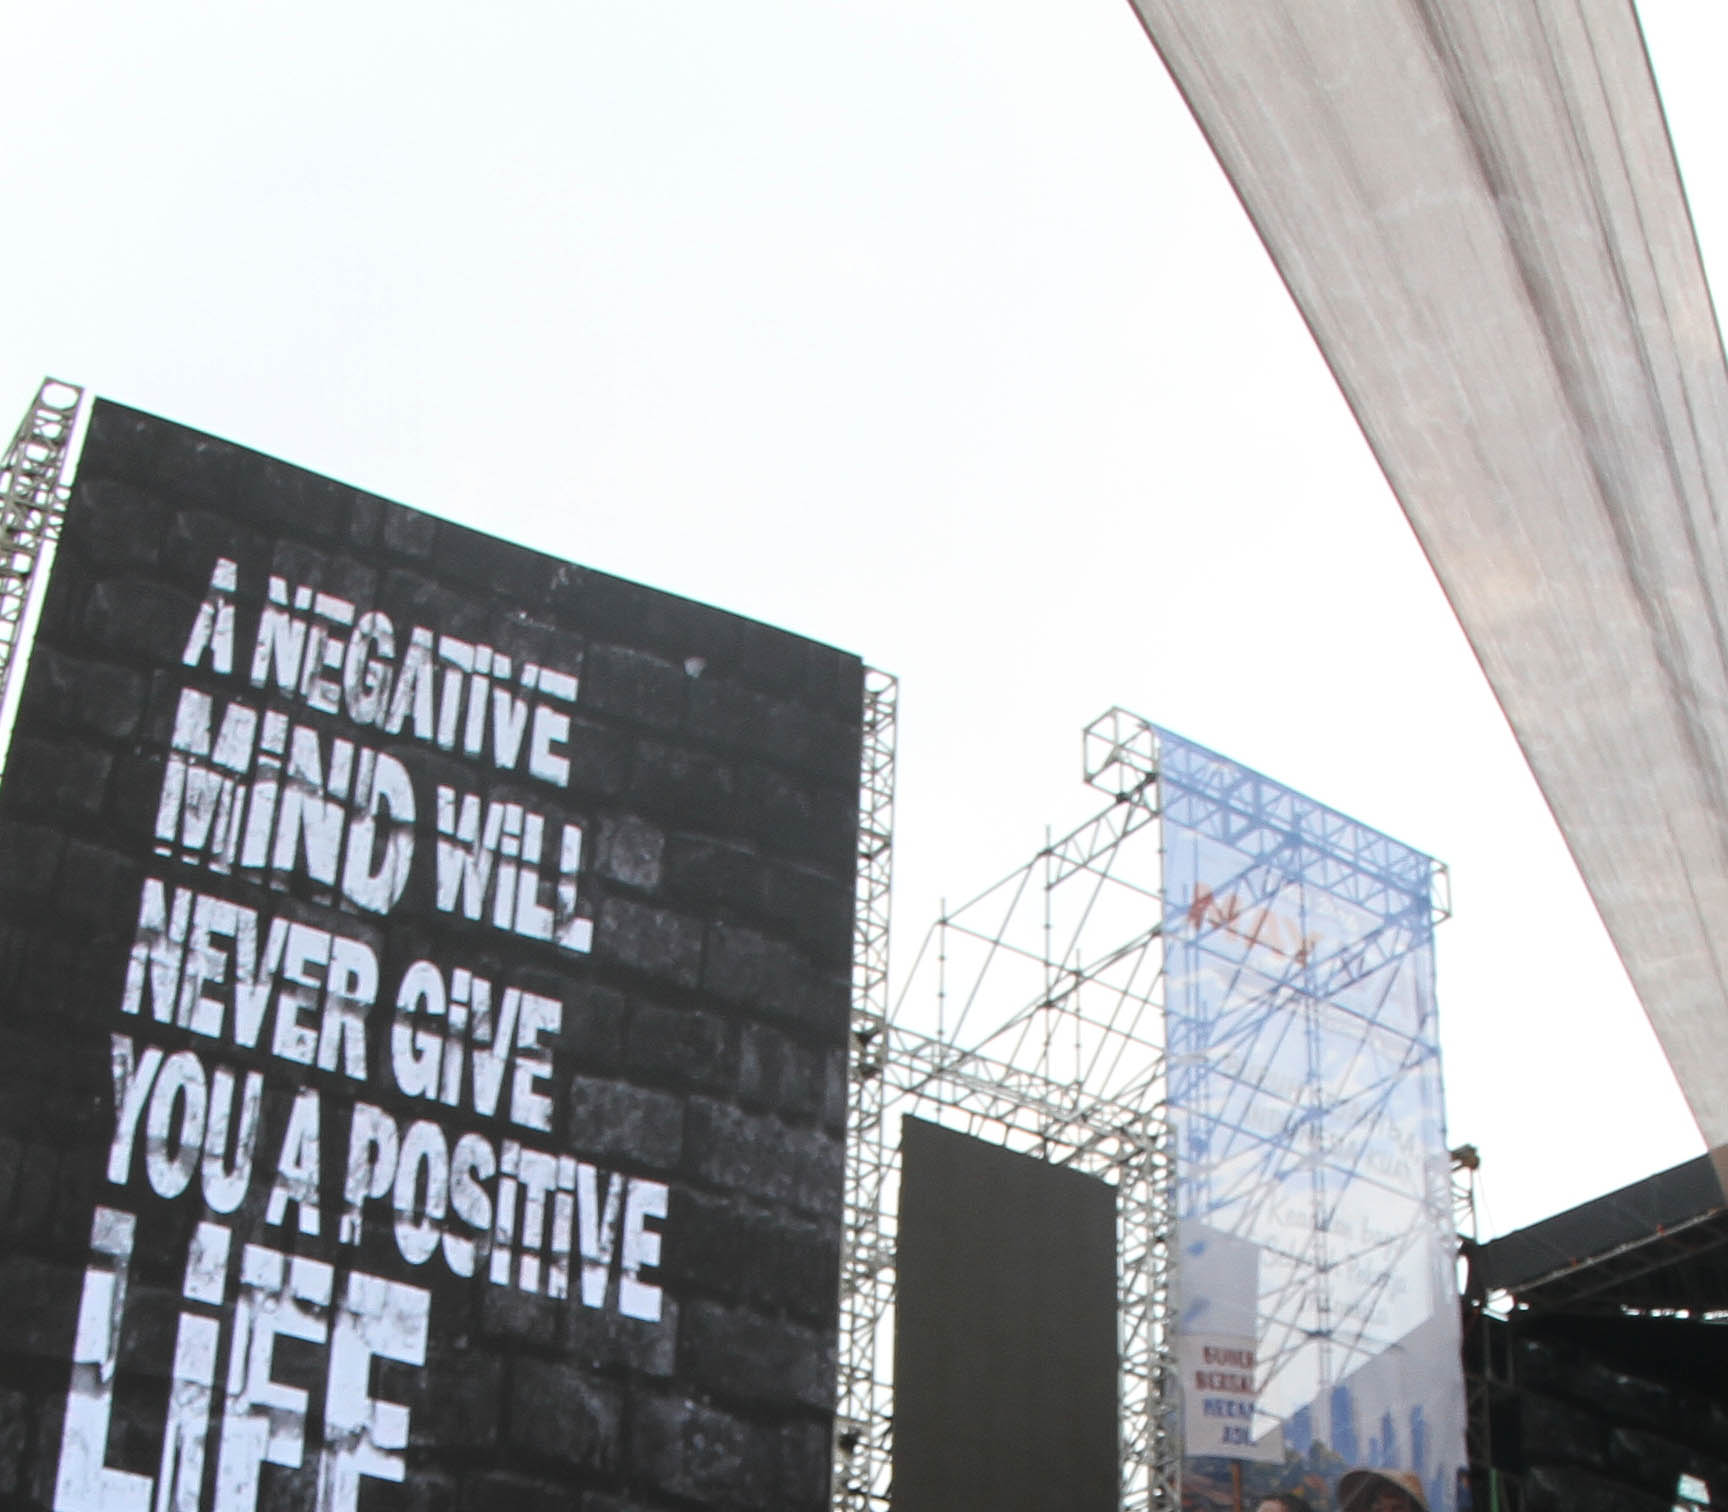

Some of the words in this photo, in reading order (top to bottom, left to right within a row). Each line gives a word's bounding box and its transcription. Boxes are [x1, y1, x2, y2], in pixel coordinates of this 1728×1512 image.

[183, 558, 237, 673] A
[437, 785, 593, 953] WILL
[123, 879, 379, 1080] NEVER
[392, 961, 562, 1131] GIVE
[108, 1035, 262, 1213] YOU
[266, 1090, 320, 1235] A
